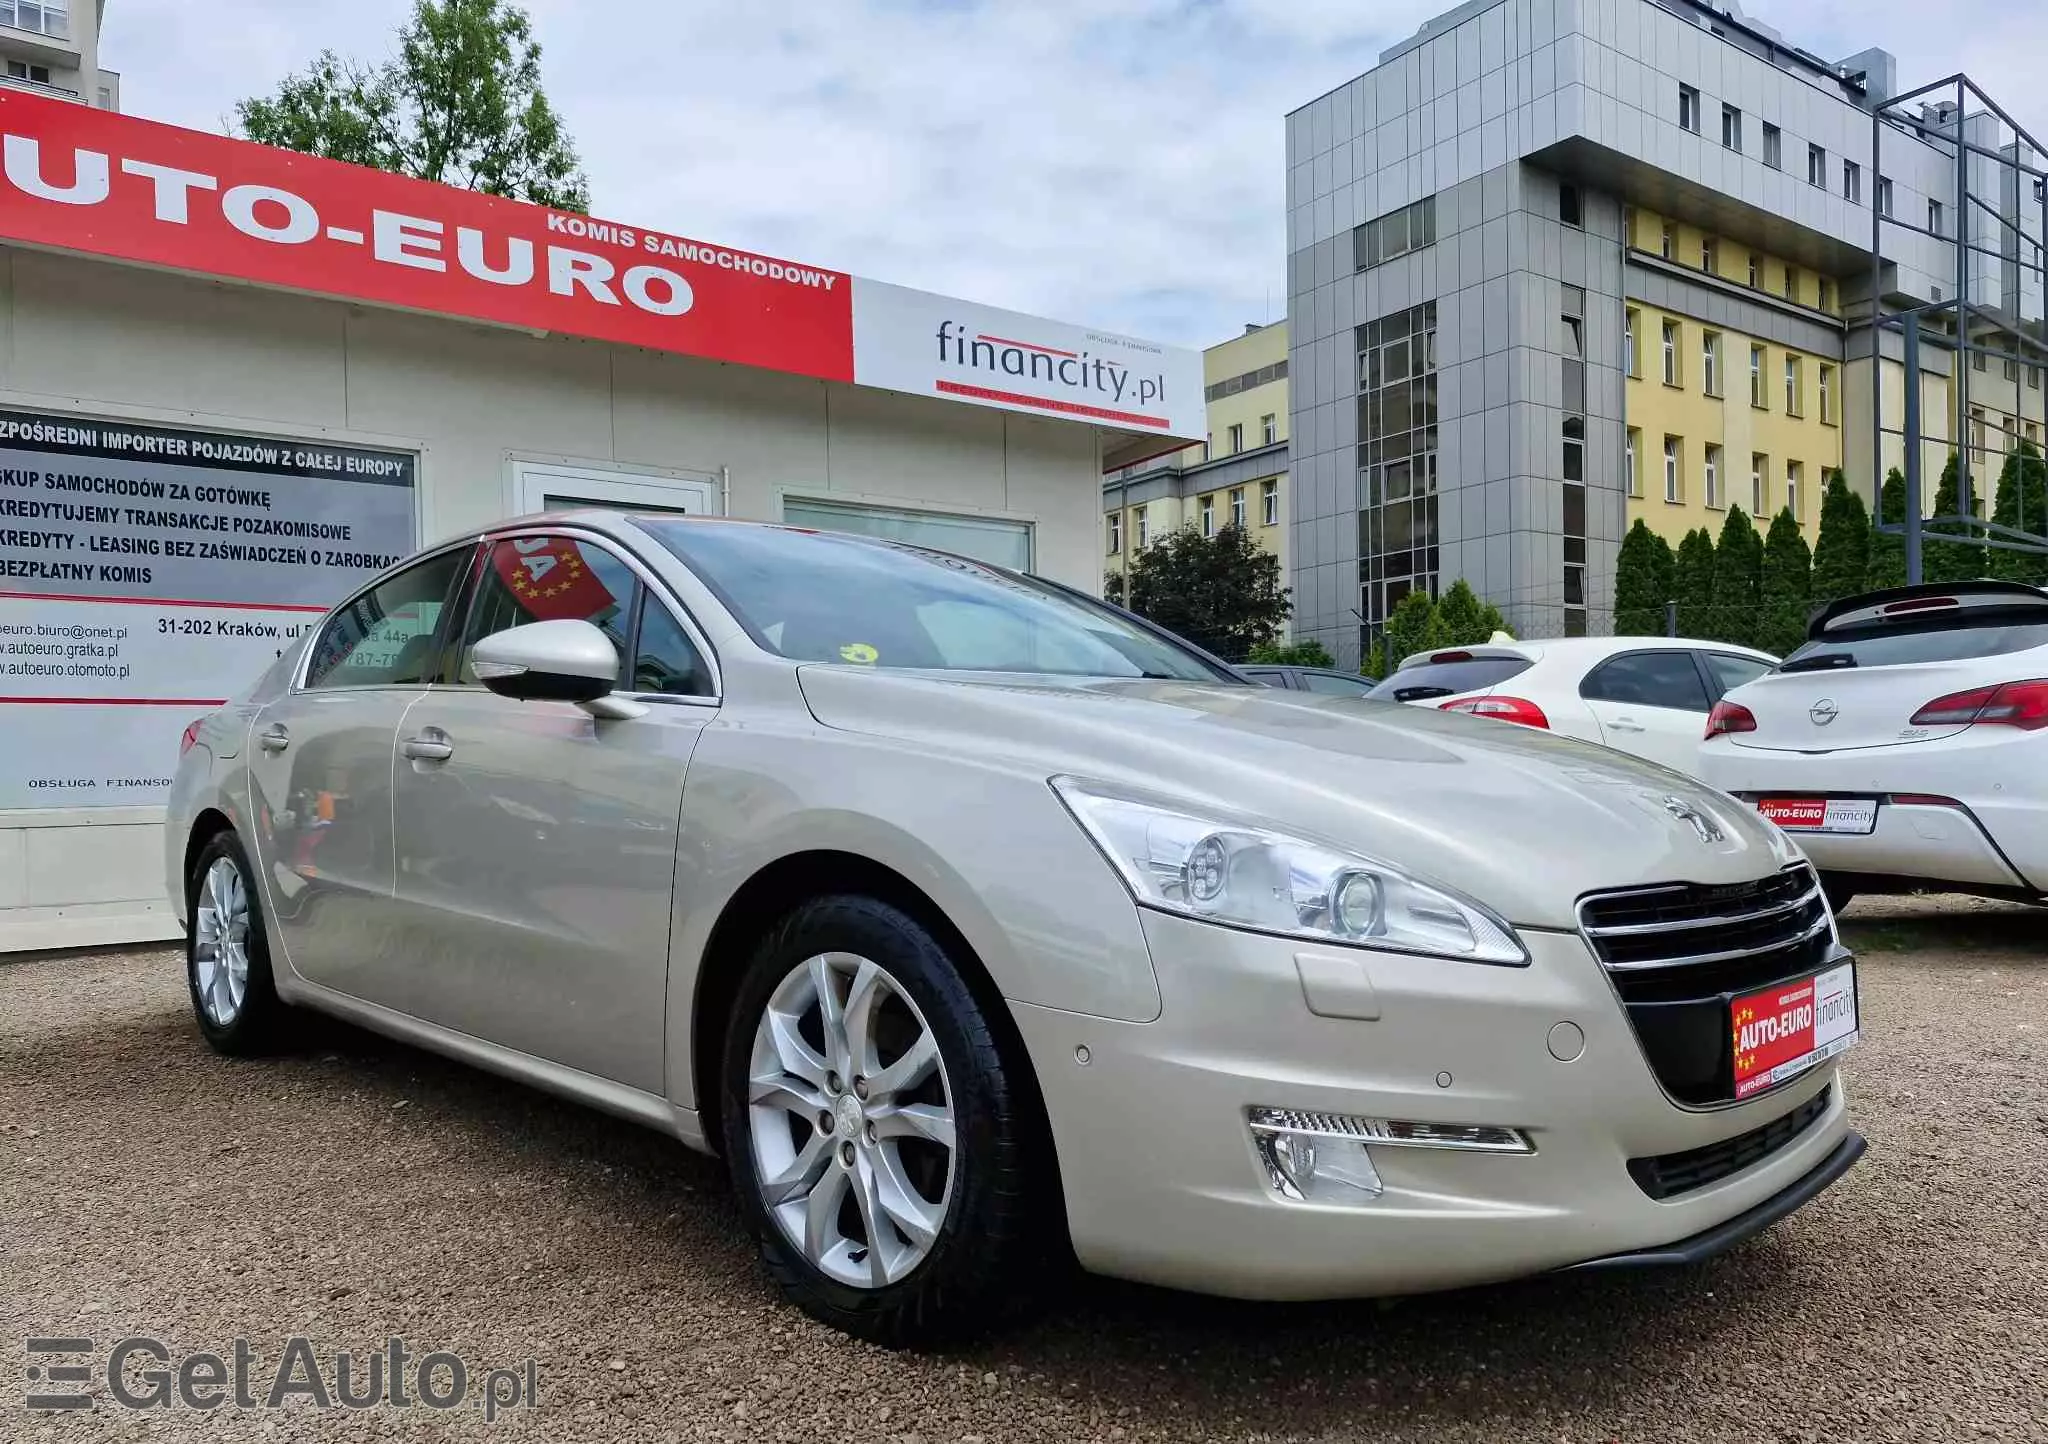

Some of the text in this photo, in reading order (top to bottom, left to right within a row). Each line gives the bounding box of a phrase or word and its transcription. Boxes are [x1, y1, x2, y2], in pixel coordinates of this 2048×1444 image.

[4, 134, 693, 316] UTO-EURO
[547, 213, 836, 291] KOMIS SAMOCHODOWY
[936, 320, 1164, 406] financity.pl
[102, 431, 188, 456] IMPORTER
[192, 441, 277, 465] POJAZDÓW
[281, 450, 293, 466] Z
[295, 452, 342, 471] CAŁEJ
[346, 458, 404, 477] EUROPY
[0, 469, 271, 512] KUP SAMOCHODÓW ZA GOTÓWKĘ
[125, 509, 229, 532] TRANSAKCJE
[233, 517, 352, 541] POZAKOMISOWE
[0, 560, 152, 584] BEZPŁATNY KOMIS
[90, 535, 160, 555] LEASING
[165, 541, 195, 557] BEZ
[200, 540, 307, 565] ZAŚWIADCZEŃ
[311, 550, 321, 566] O
[325, 551, 404, 570] ZAROBKA
[158, 619, 212, 635] 31-202
[217, 620, 281, 640] Kraków,
[28, 778, 173, 788] OBSŁUGA FINANSO
[1762, 808, 1822, 819] AUTO-EURO
[1739, 1004, 1812, 1053] AUTO-EURO
